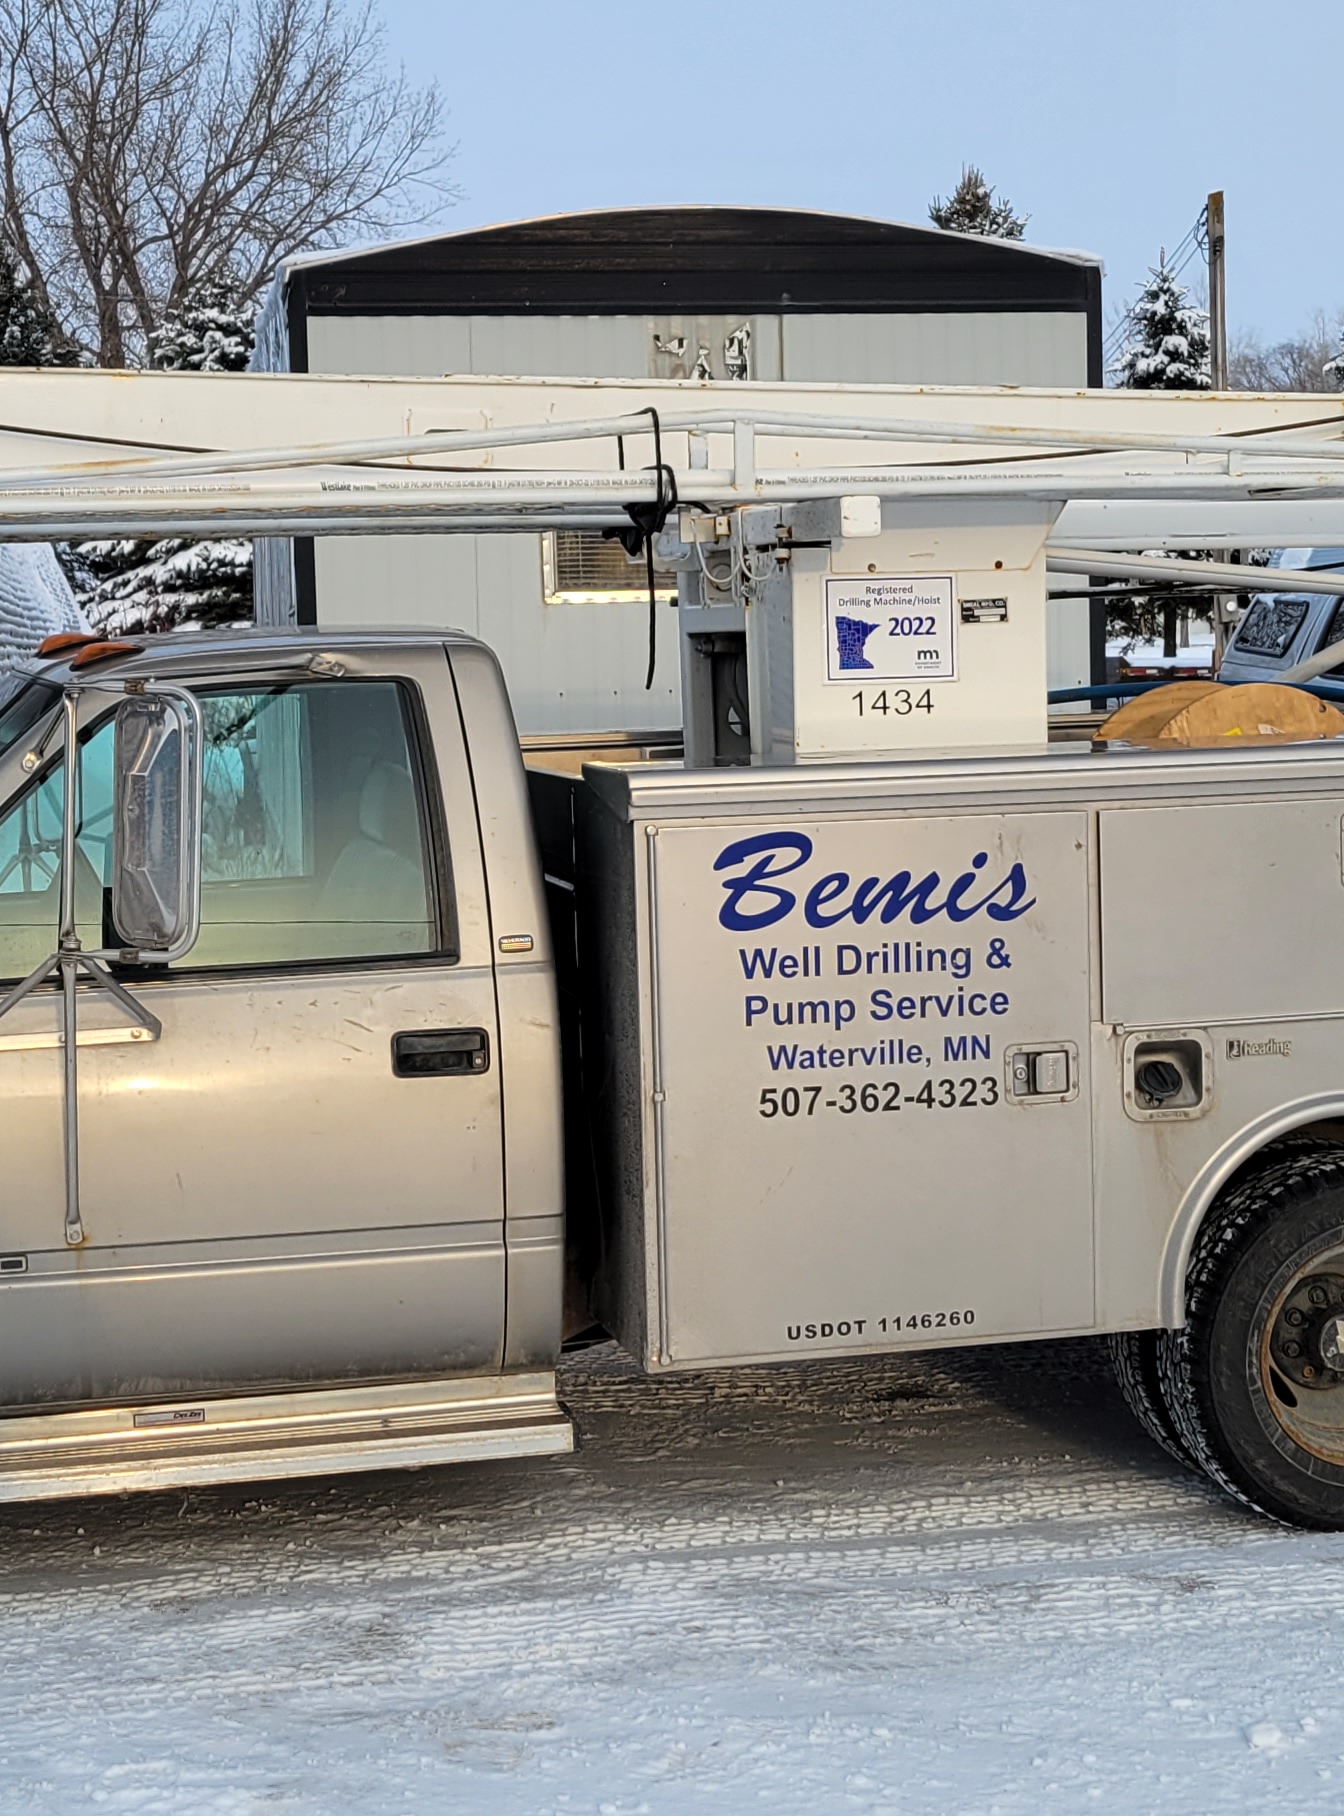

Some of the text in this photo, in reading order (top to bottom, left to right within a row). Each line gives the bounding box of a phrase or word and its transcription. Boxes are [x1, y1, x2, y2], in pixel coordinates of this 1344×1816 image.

[838, 597, 941, 607] Drilling Machine/Hoist
[865, 585, 913, 596] Registered
[888, 616, 937, 636] 2022
[852, 688, 935, 716] 1434
[713, 831, 1037, 931] Bemis
[739, 937, 1012, 980] Well Drilling &
[745, 986, 1010, 1030] Pump Service
[767, 1034, 991, 1070] Waterville, MN
[1243, 1038, 1291, 1056] Reading
[759, 1076, 999, 1118] 507-362-4323
[787, 1310, 975, 1340] USDOT 1146260
